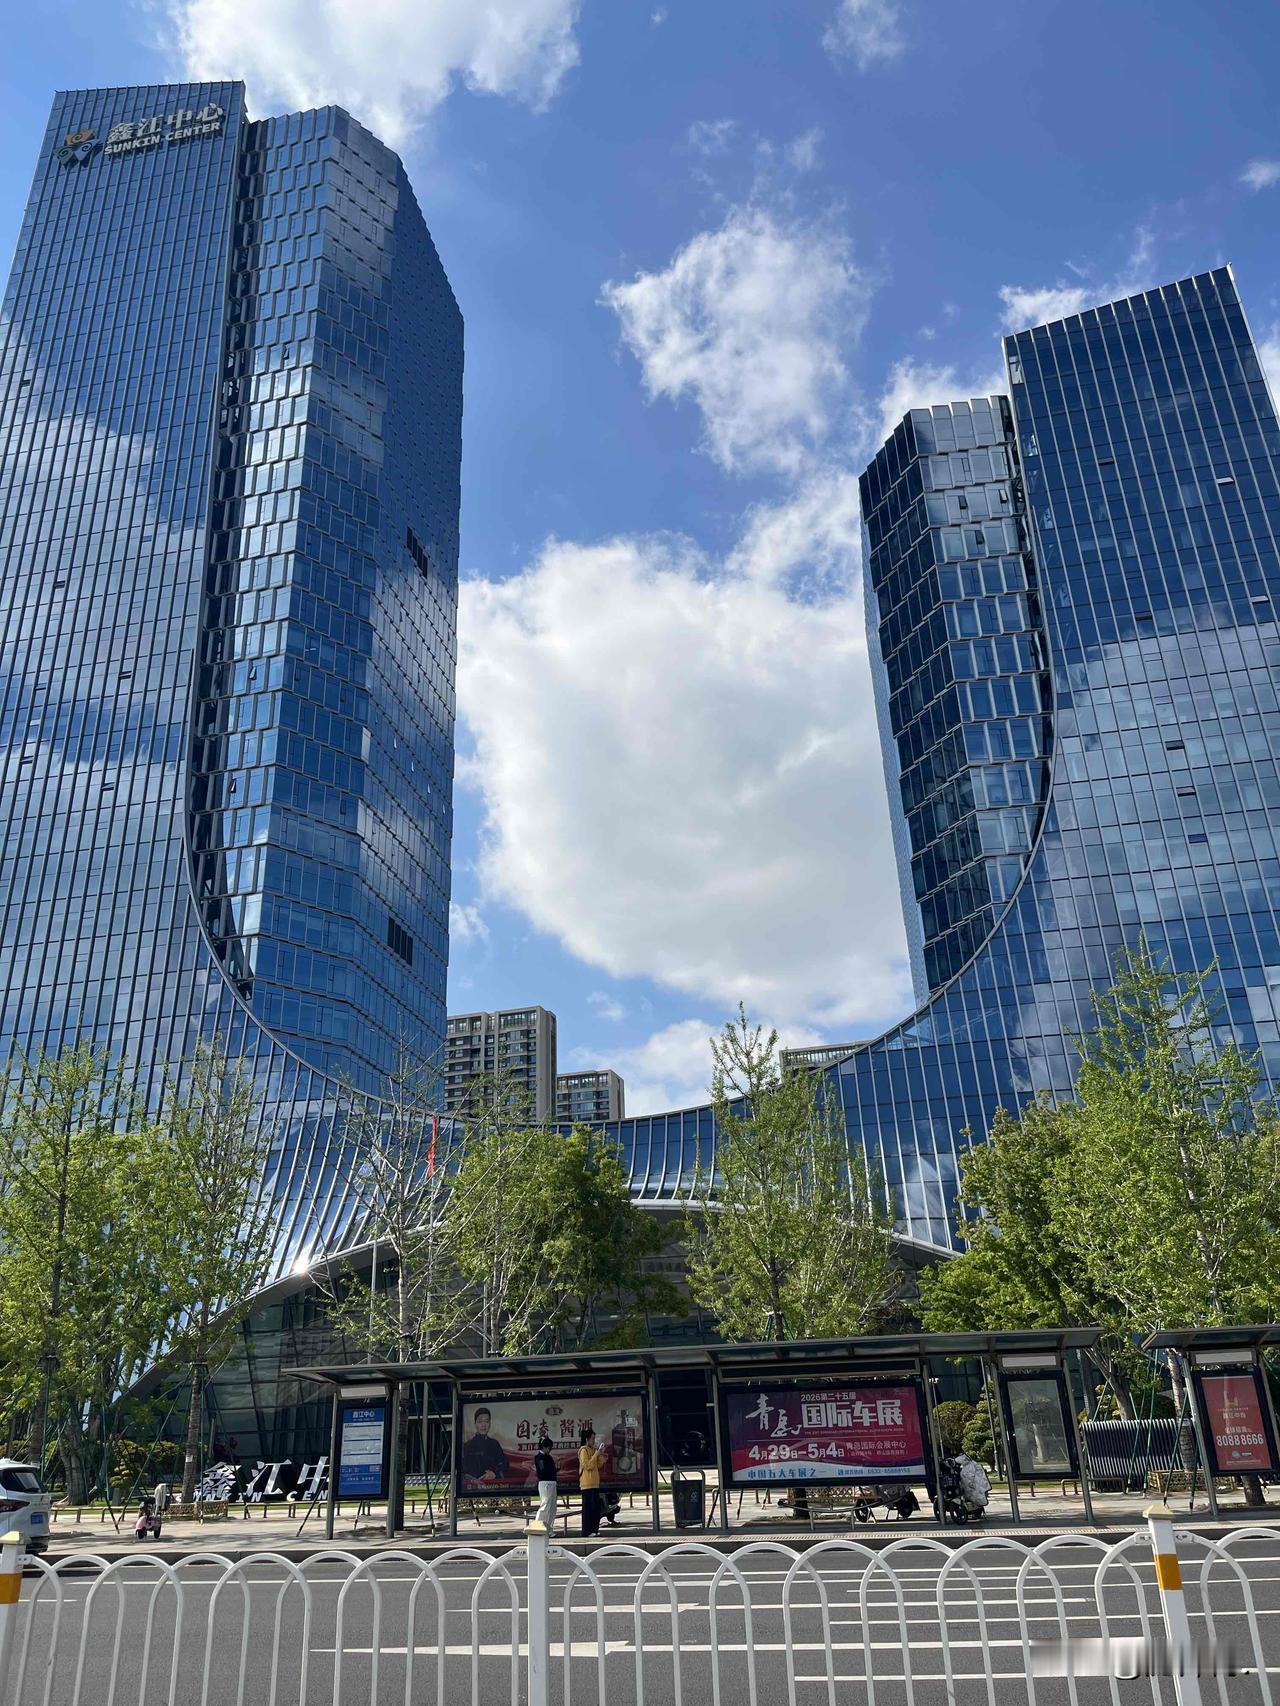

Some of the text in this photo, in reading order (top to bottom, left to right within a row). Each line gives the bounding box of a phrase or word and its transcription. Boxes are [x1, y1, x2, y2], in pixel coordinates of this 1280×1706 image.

[104, 121, 221, 155] SUNKIN CENTER
[107, 102, 224, 144] 鑫江中心
[801, 1399, 904, 1428] 国际车展
[747, 1467, 828, 1480] 中国五大车展之一
